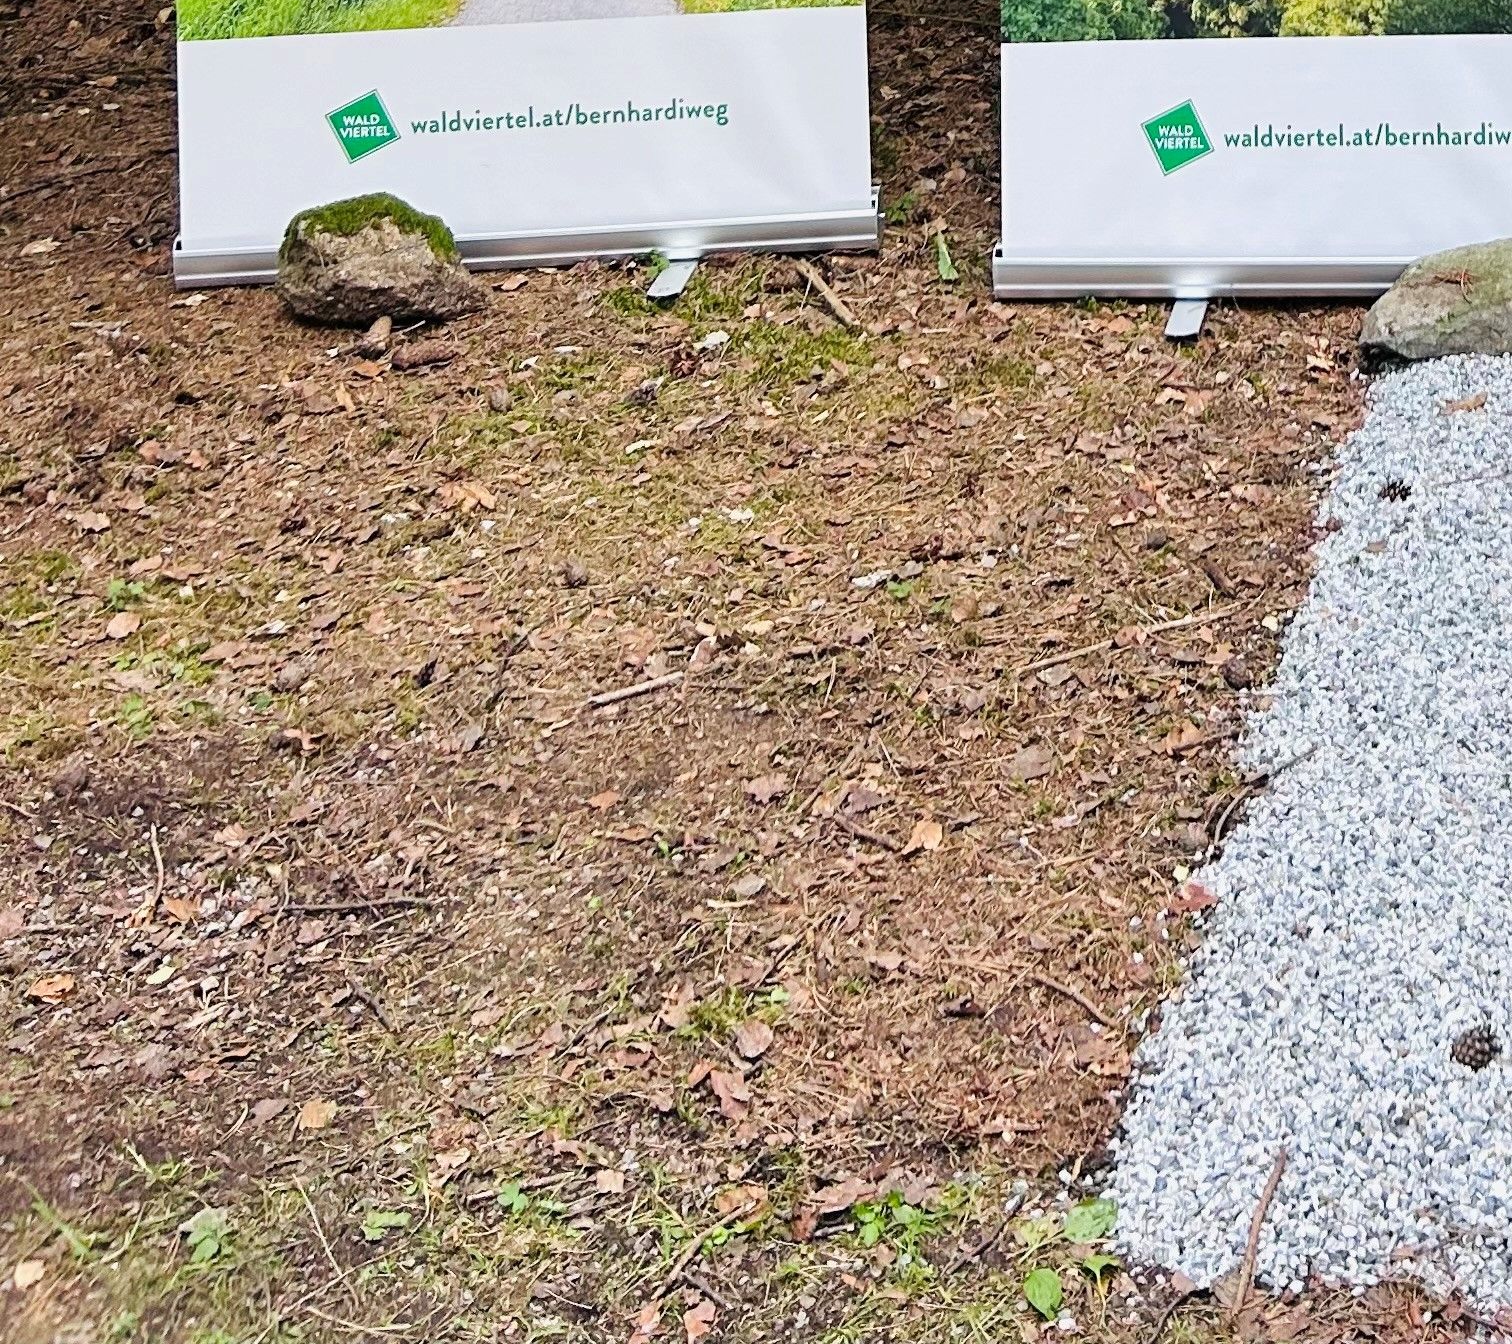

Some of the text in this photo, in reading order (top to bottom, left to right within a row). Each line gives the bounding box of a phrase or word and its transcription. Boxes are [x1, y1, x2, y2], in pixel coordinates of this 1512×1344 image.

[342, 112, 379, 126] WALD
[411, 99, 729, 134] waldviertel.at/bernhardiweg
[340, 124, 390, 139] VIERTEL
[1158, 124, 1194, 136] WALD
[1155, 135, 1204, 150] VIERTEL
